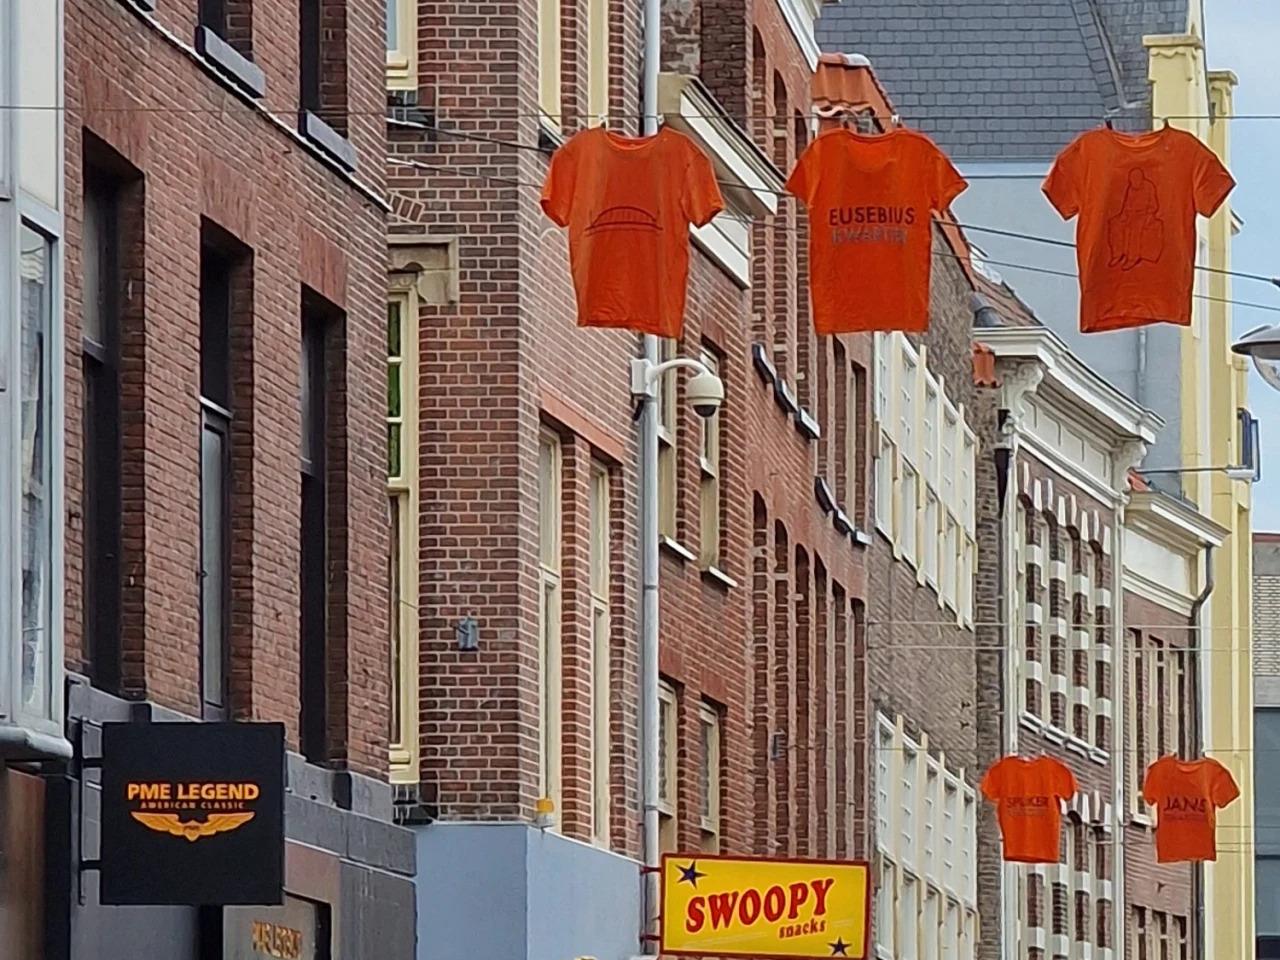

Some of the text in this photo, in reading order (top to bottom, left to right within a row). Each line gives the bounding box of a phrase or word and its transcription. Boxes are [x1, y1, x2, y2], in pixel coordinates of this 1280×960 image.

[829, 206, 916, 226] EUSEBIUS
[127, 783, 260, 800] PME LEGEND
[140, 801, 245, 810] AMERICAN CLASSIC
[1163, 796, 1206, 813] JANS
[686, 878, 834, 933] SWOOPY
[778, 917, 827, 940] snacks
